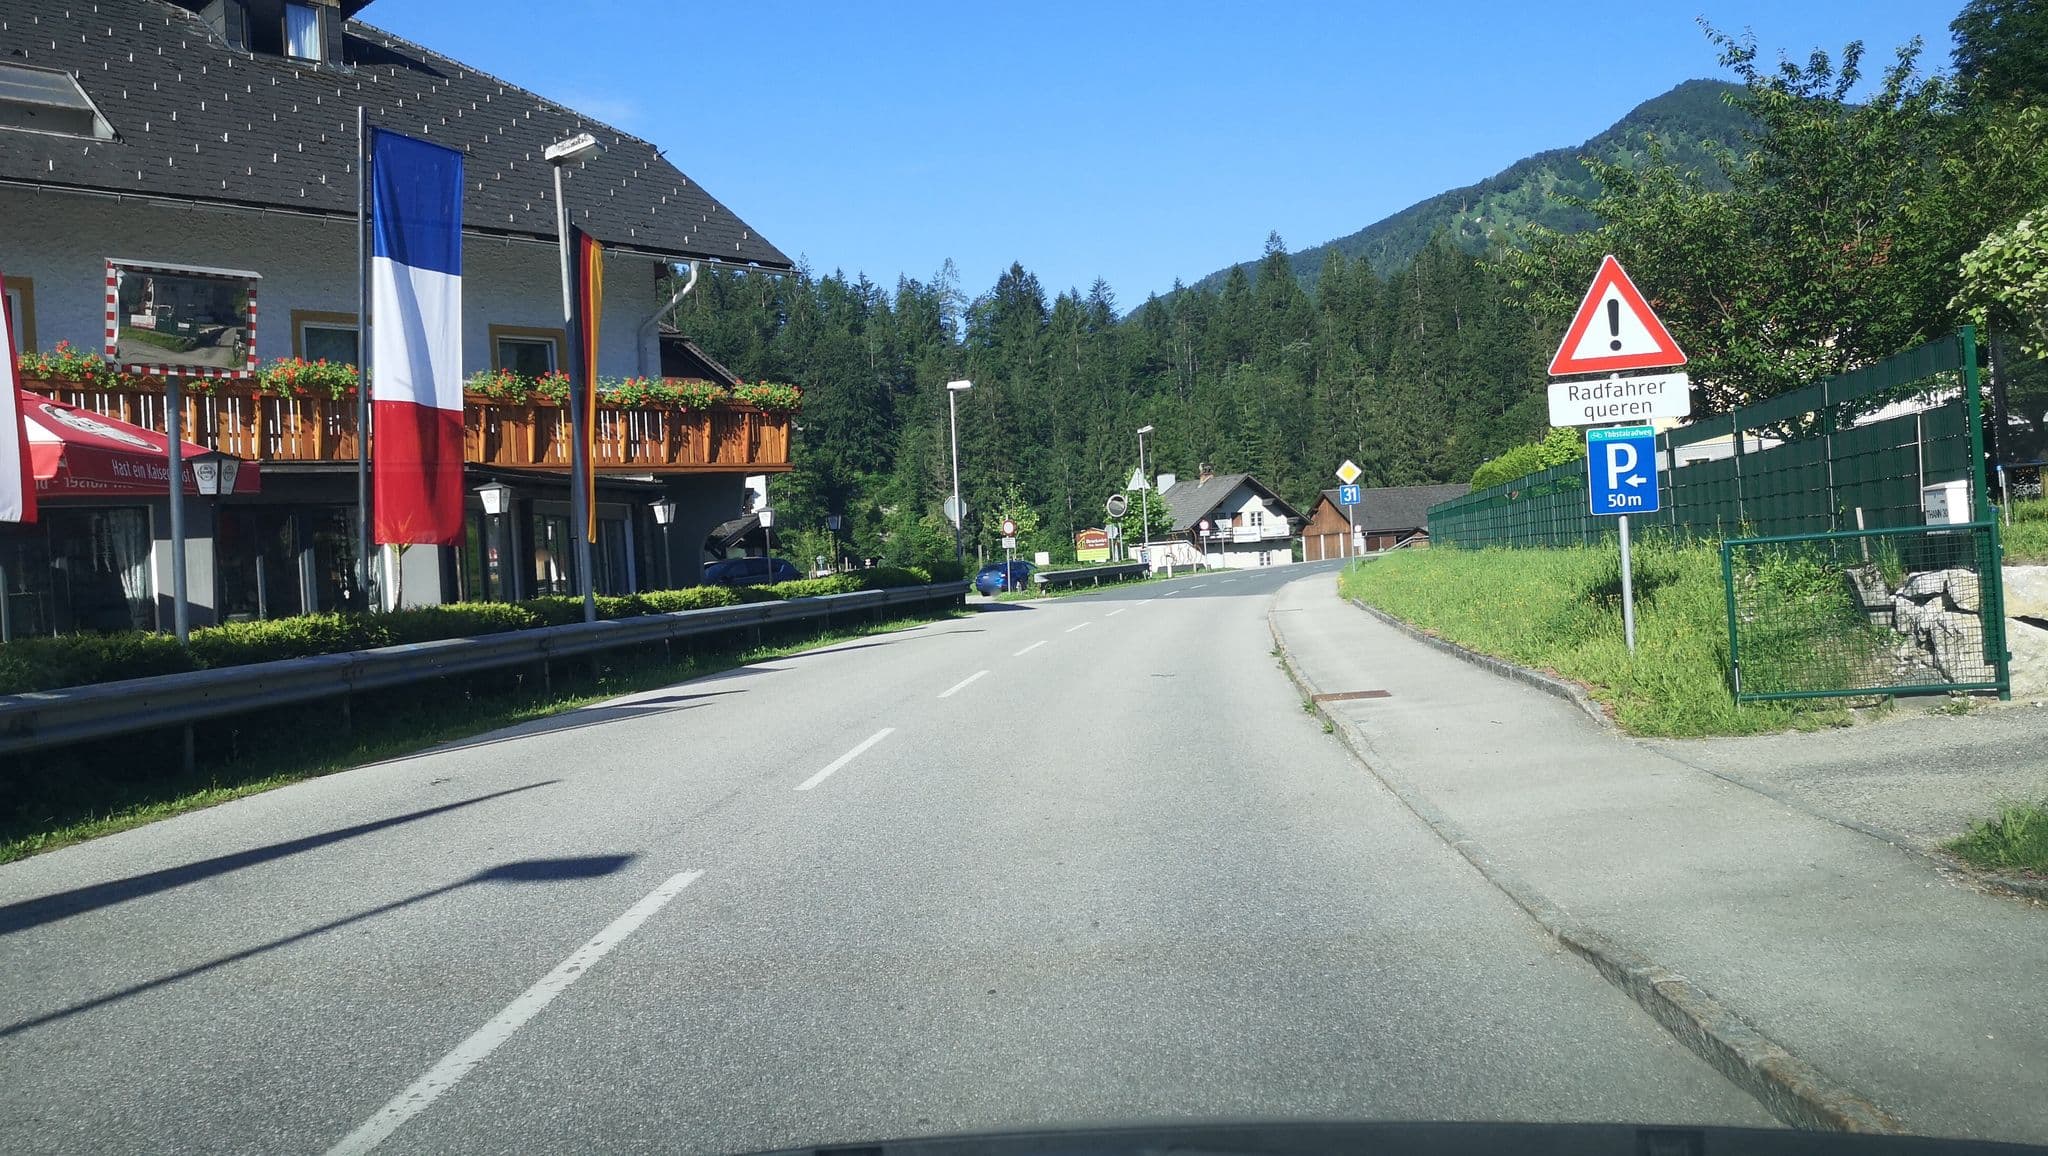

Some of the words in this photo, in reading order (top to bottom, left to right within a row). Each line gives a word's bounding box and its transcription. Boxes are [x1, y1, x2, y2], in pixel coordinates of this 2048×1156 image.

[1569, 381, 1666, 401] Radfahrer
[1584, 401, 1652, 421] queren
[112, 459, 132, 477] Hast
[133, 461, 146, 479] ein
[1606, 442, 1638, 490] P
[1344, 487, 1357, 501] 31
